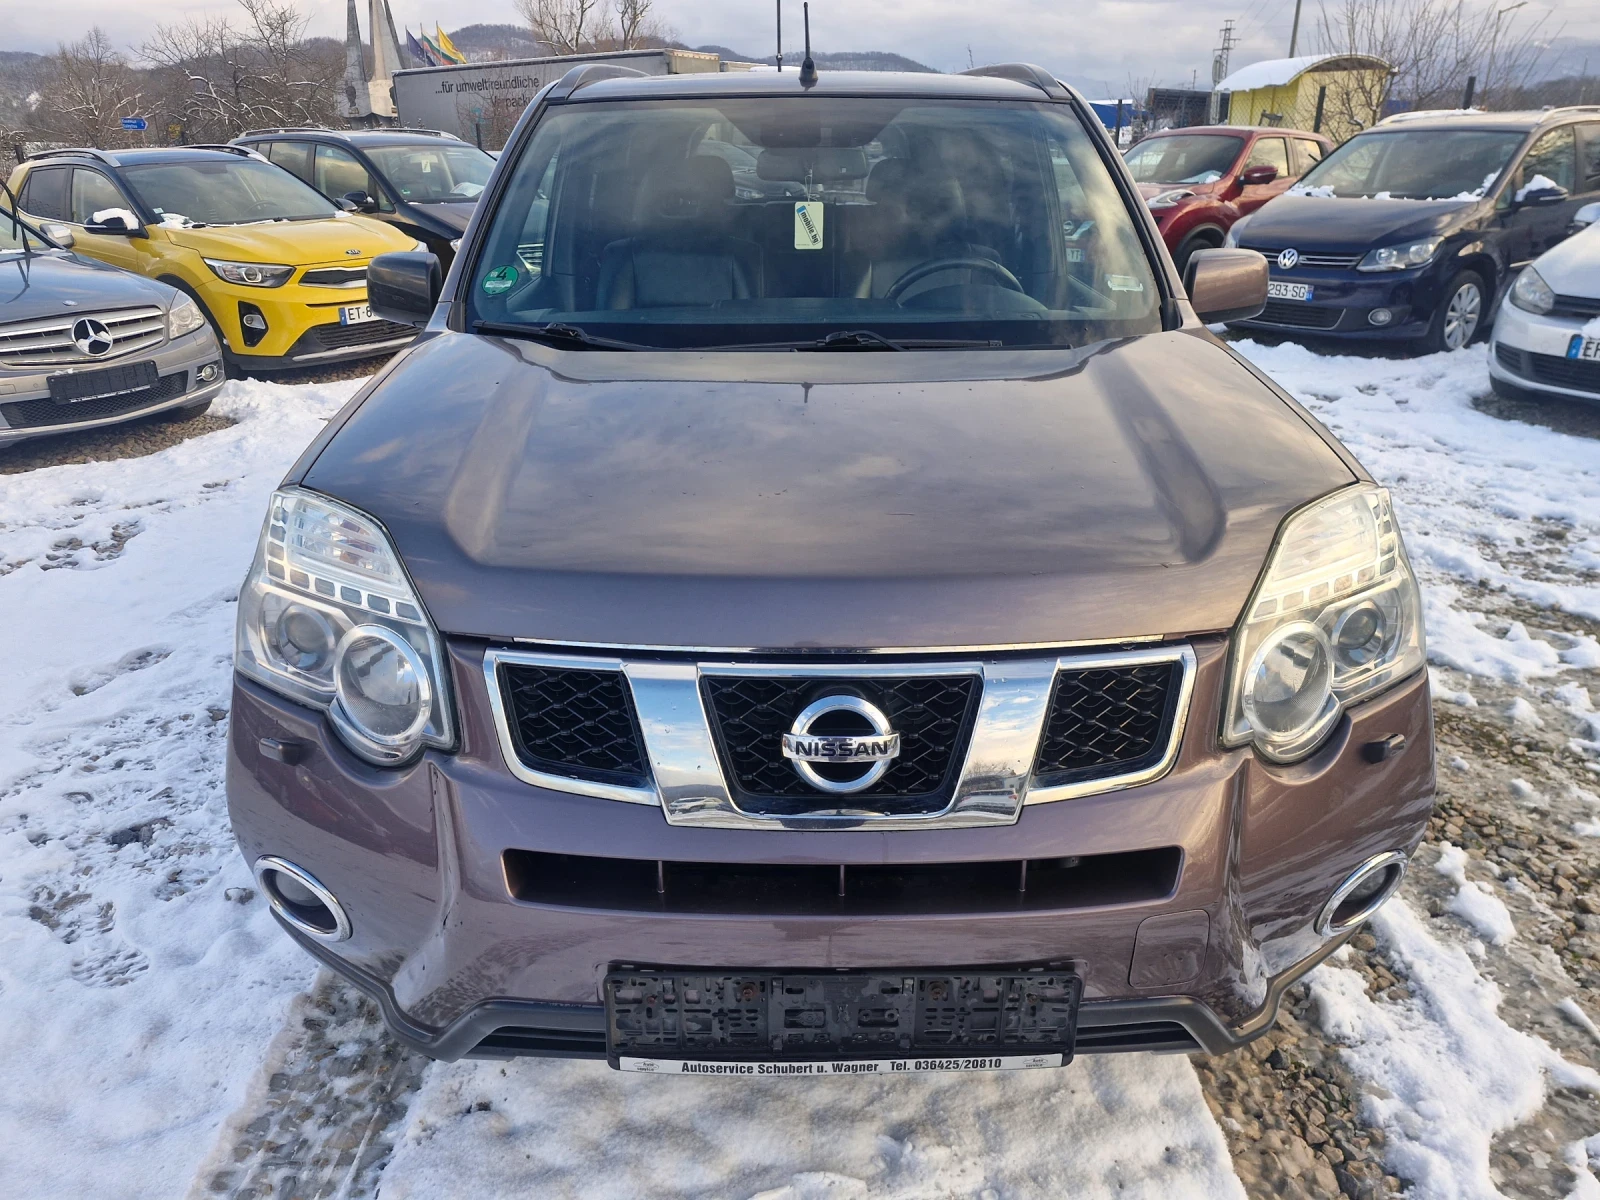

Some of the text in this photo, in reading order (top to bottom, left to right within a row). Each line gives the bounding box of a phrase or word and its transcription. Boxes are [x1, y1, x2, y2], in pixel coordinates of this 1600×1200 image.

[456, 76, 539, 93] umweltfreundliche
[496, 266, 507, 280] 4
[1269, 283, 1306, 298] 293-SG
[348, 305, 377, 320] ET-8
[795, 741, 888, 757] NISSAN
[681, 1058, 1002, 1074] Autoservice Schubert u. Wagner Tel. 036425/20810
